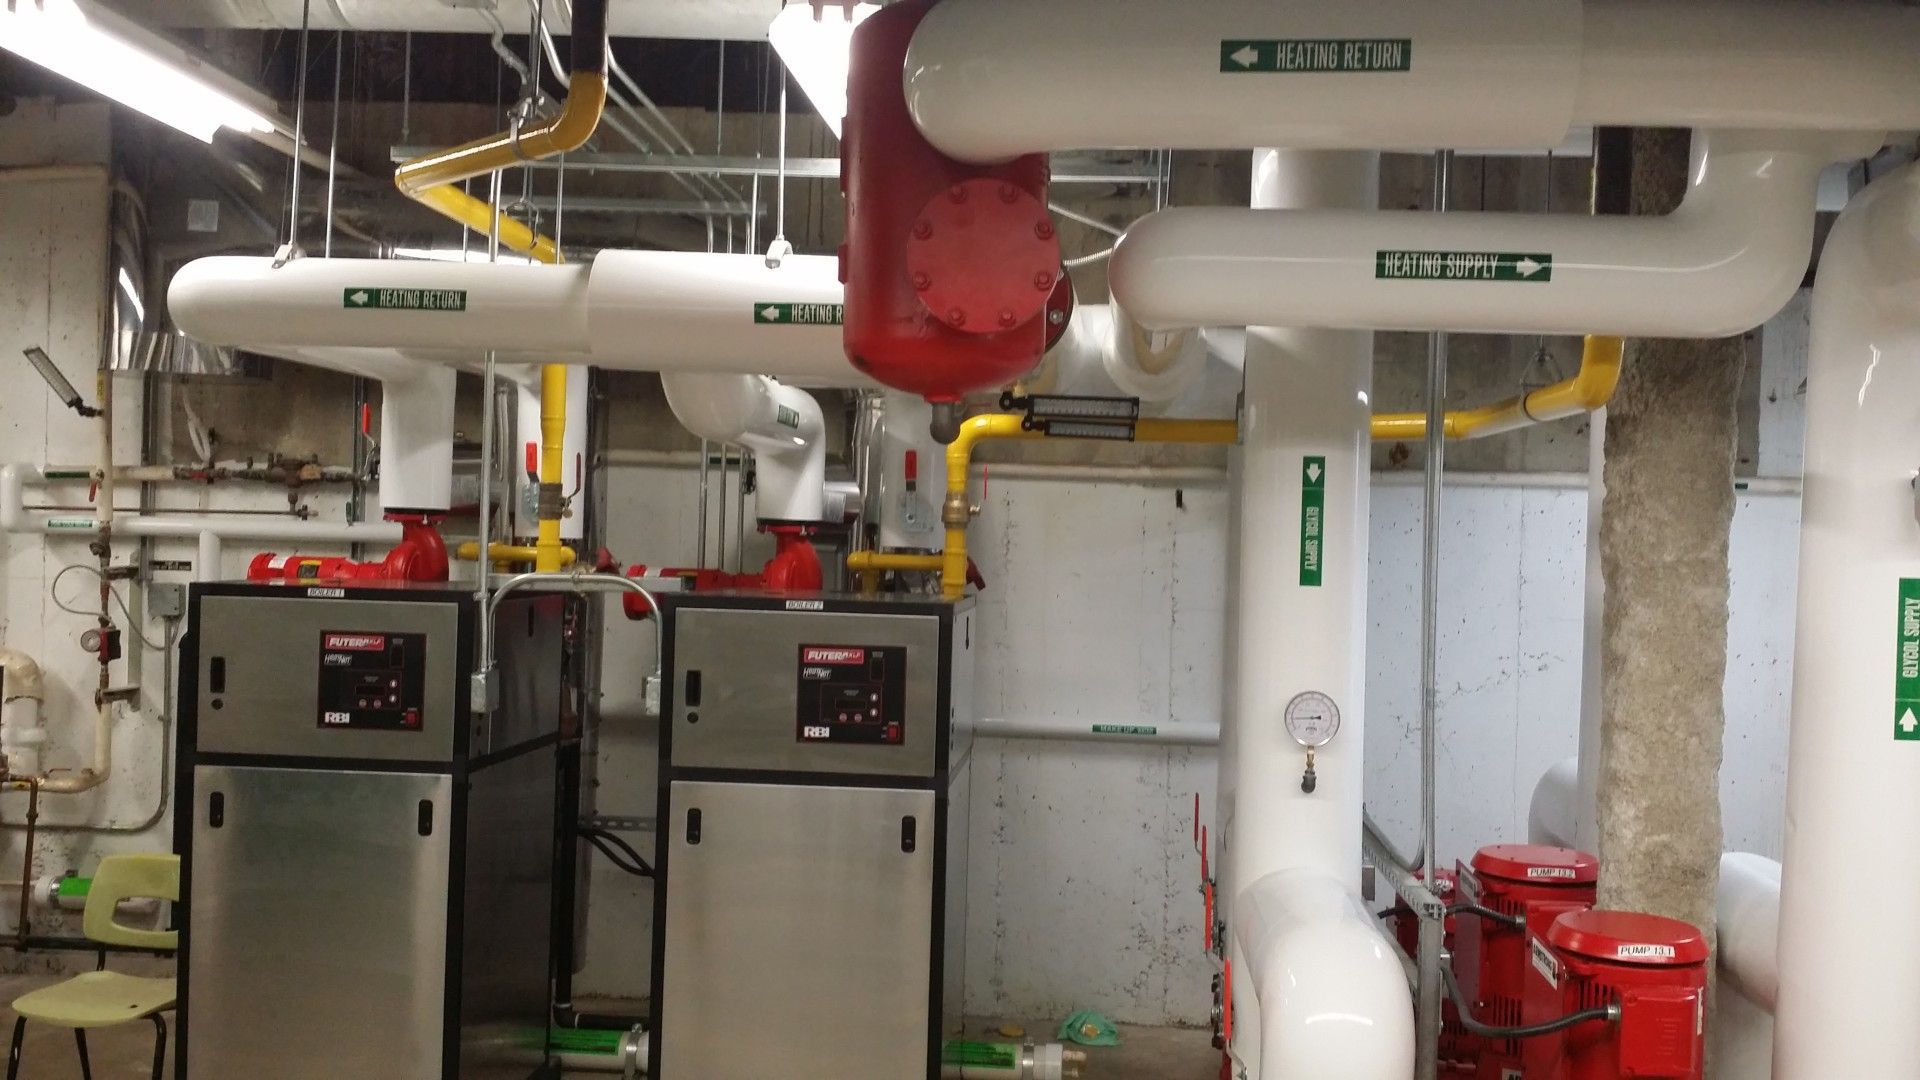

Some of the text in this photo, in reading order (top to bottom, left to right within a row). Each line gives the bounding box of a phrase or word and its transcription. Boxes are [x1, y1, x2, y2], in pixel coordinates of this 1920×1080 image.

[1276, 41, 1402, 69] HEATING RETURN
[1384, 251, 1499, 279] HEATING SUPPLY
[380, 288, 461, 310] HEATING RETURN
[791, 304, 832, 323] HEATING
[1902, 597, 1920, 679] GLYCOL SUPPLY
[325, 711, 350, 724] RBI
[804, 726, 830, 738] RBI
[1530, 868, 1556, 877] PUMP
[1620, 944, 1651, 955] PUMP
